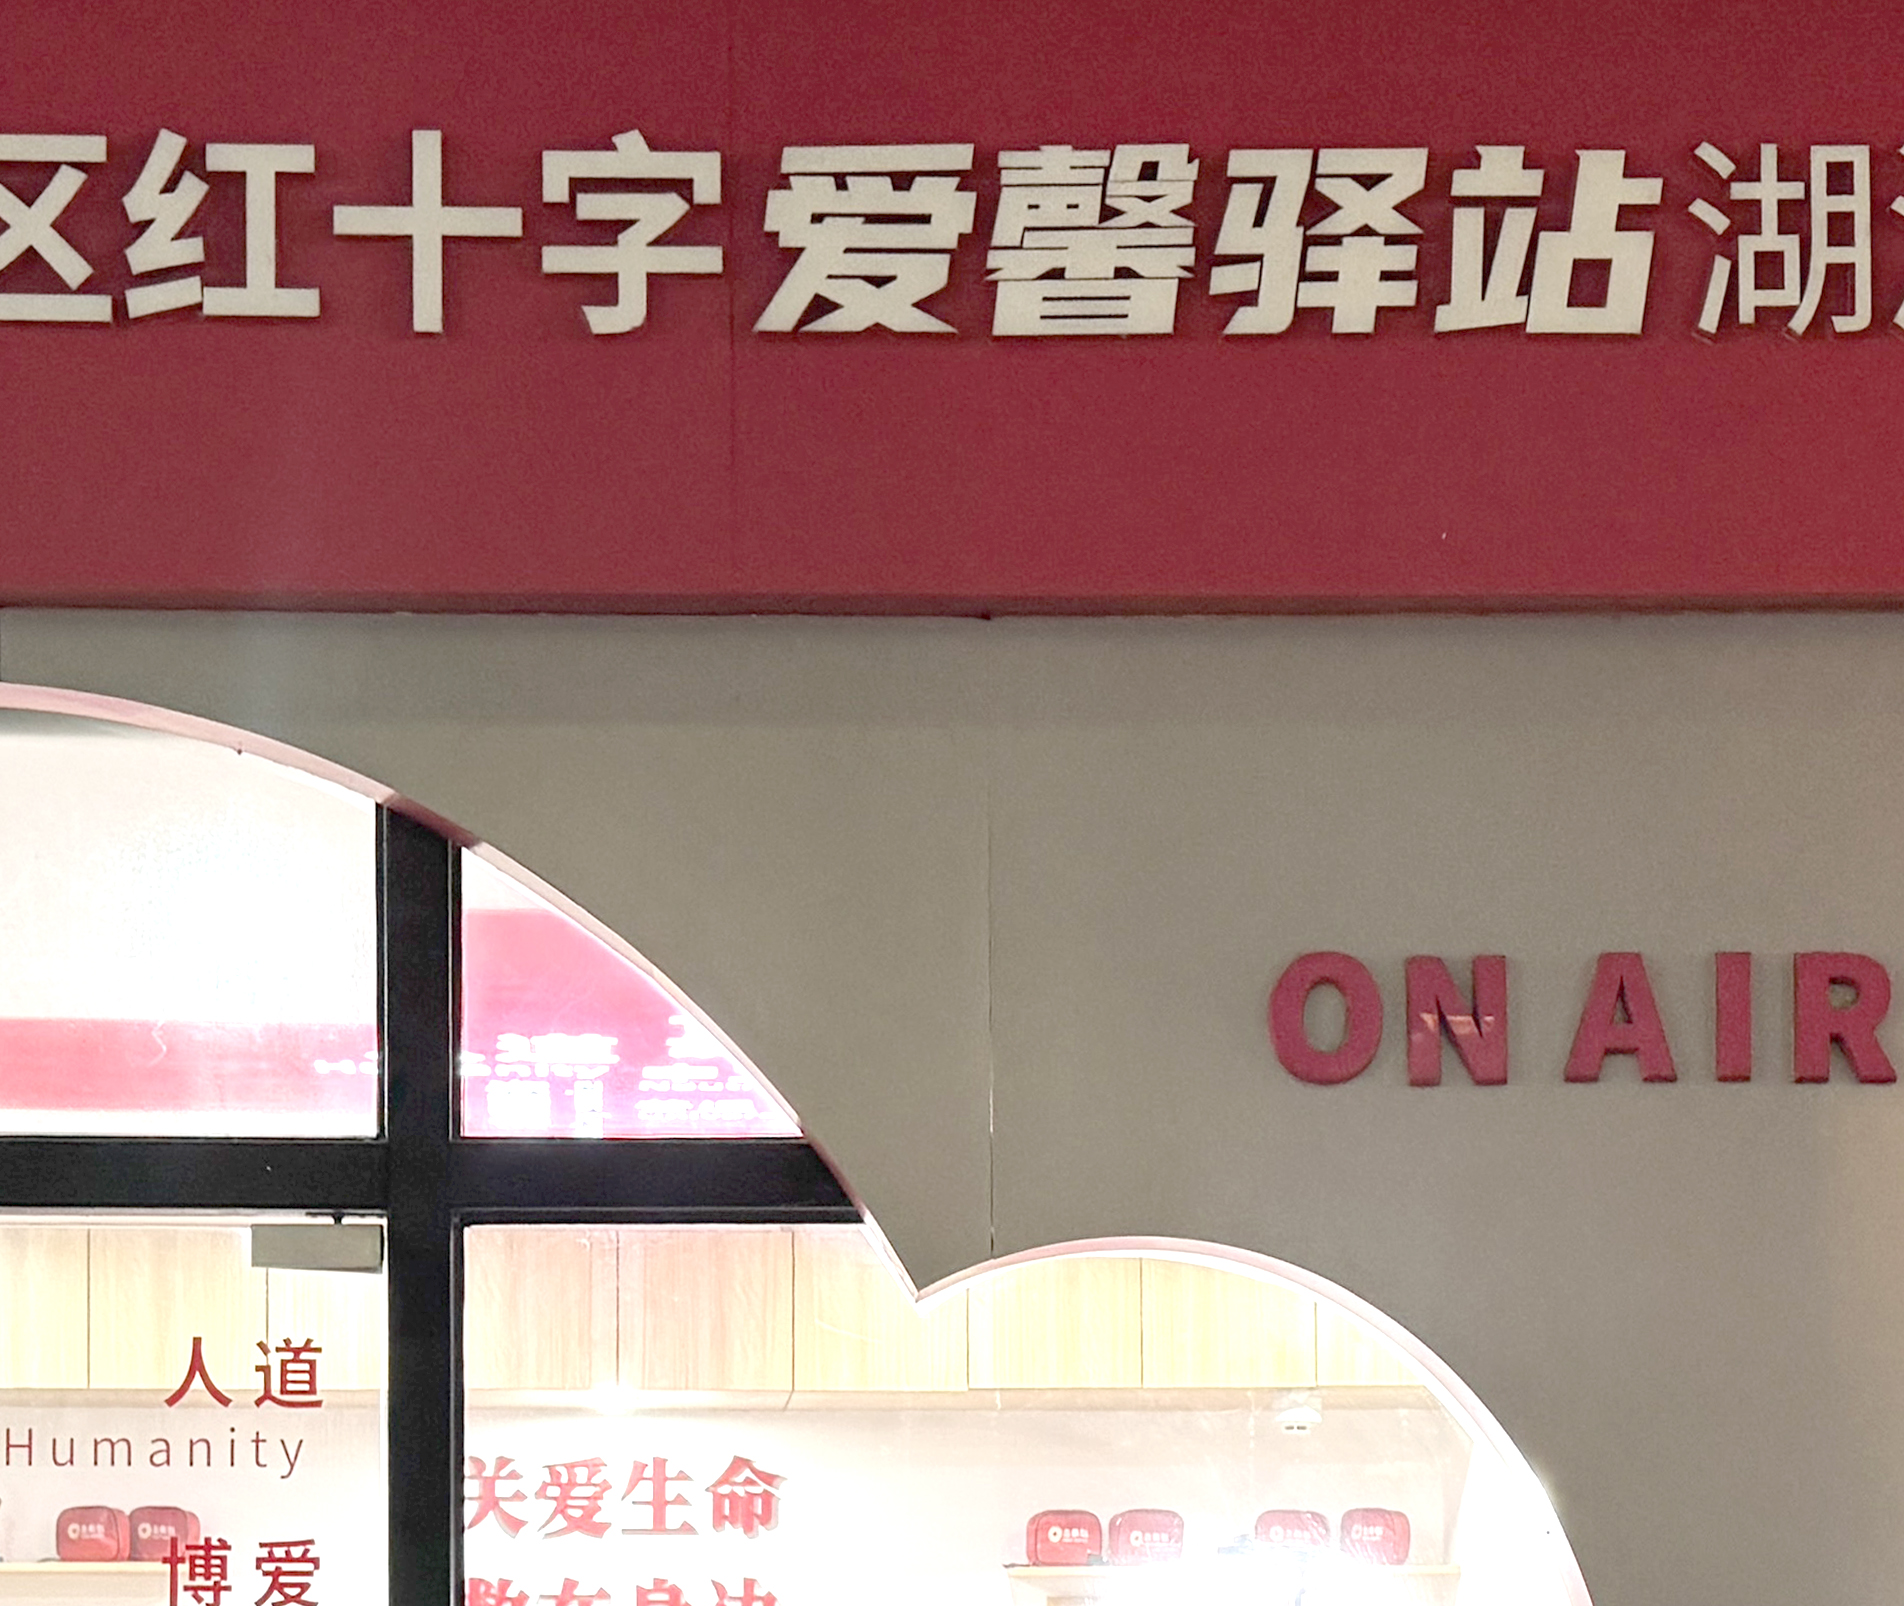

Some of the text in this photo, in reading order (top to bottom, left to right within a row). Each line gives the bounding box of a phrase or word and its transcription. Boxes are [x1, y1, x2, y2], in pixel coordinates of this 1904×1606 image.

[1268, 951, 1897, 1088] ON AIR
[164, 1336, 324, 1410] 人道
[4, 1427, 304, 1479] Humanity
[462, 1455, 788, 1540] 关爱生命
